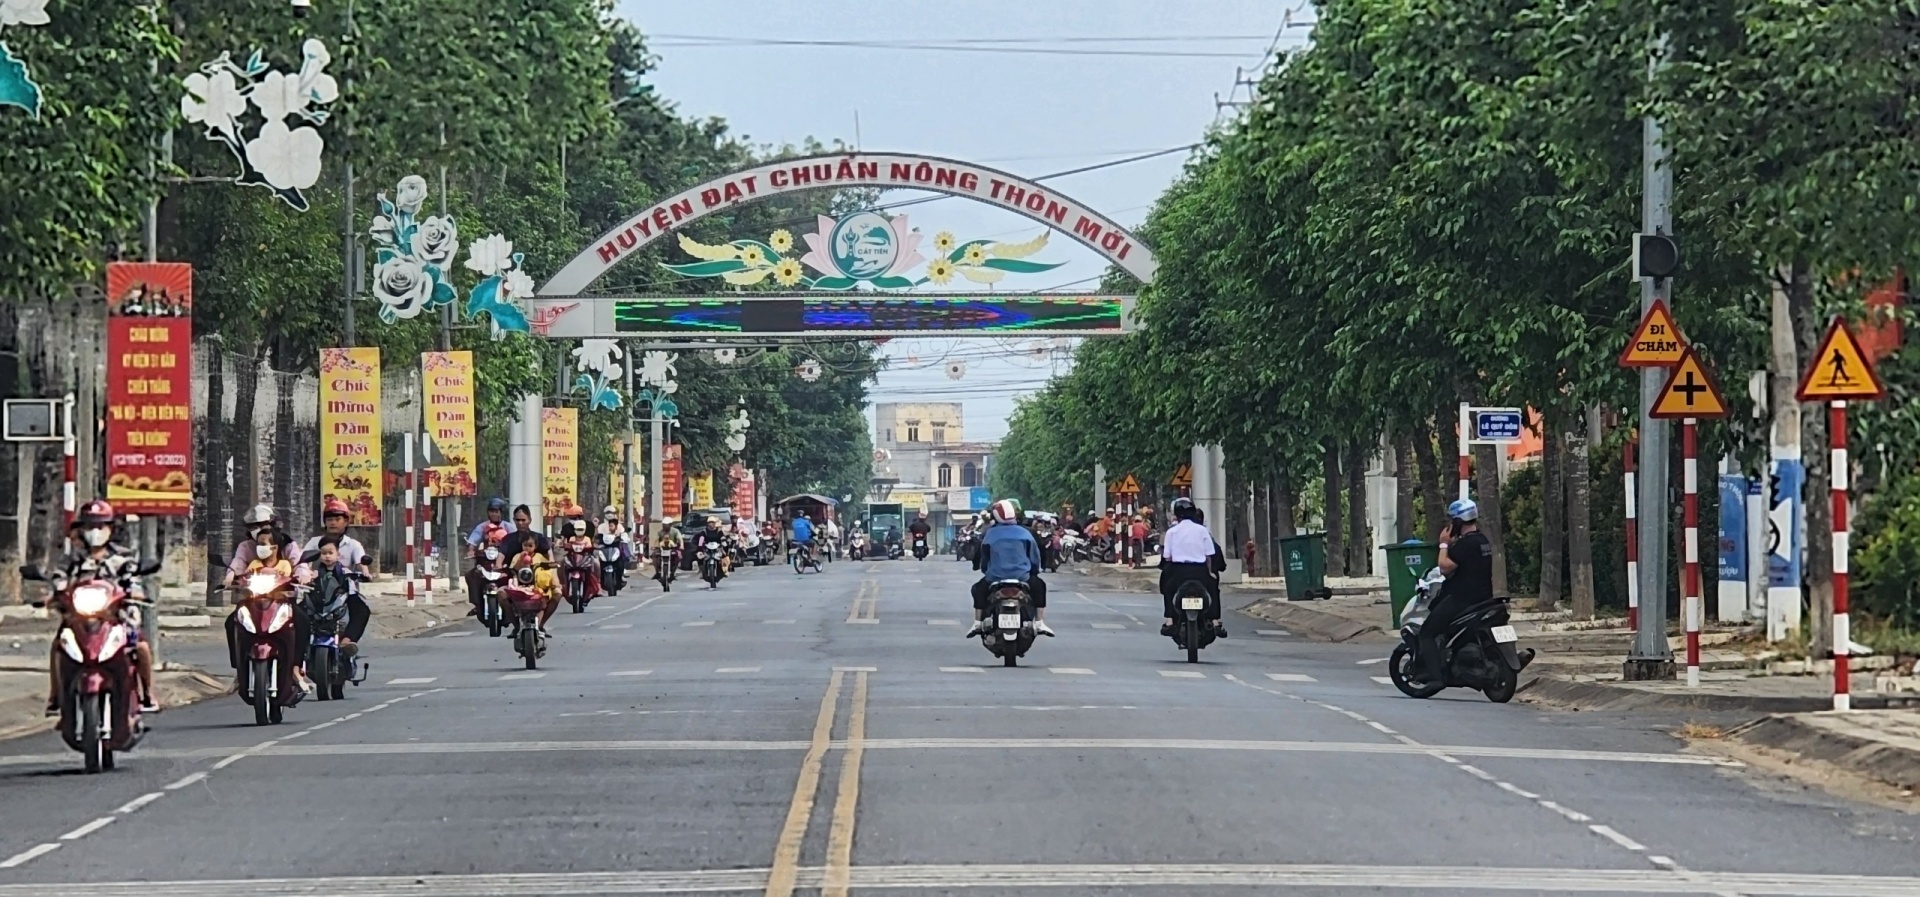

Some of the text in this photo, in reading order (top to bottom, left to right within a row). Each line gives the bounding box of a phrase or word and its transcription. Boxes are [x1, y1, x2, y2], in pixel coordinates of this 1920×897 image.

[596, 156, 1132, 264] HUYỆN ĐẠT CHUẨN NÔNG THÔN MỚI
[1650, 324, 1666, 335] ĐI
[1636, 338, 1678, 354] CHẬM
[331, 379, 370, 392] Chúc
[434, 376, 465, 387] Chúc
[431, 394, 469, 408] Mừng
[327, 400, 375, 416] Mừng
[436, 411, 465, 422] Năm
[334, 422, 370, 435] Năm
[1481, 422, 1489, 430] LÊ
[438, 428, 464, 438] Mới
[336, 443, 368, 456] Mới
